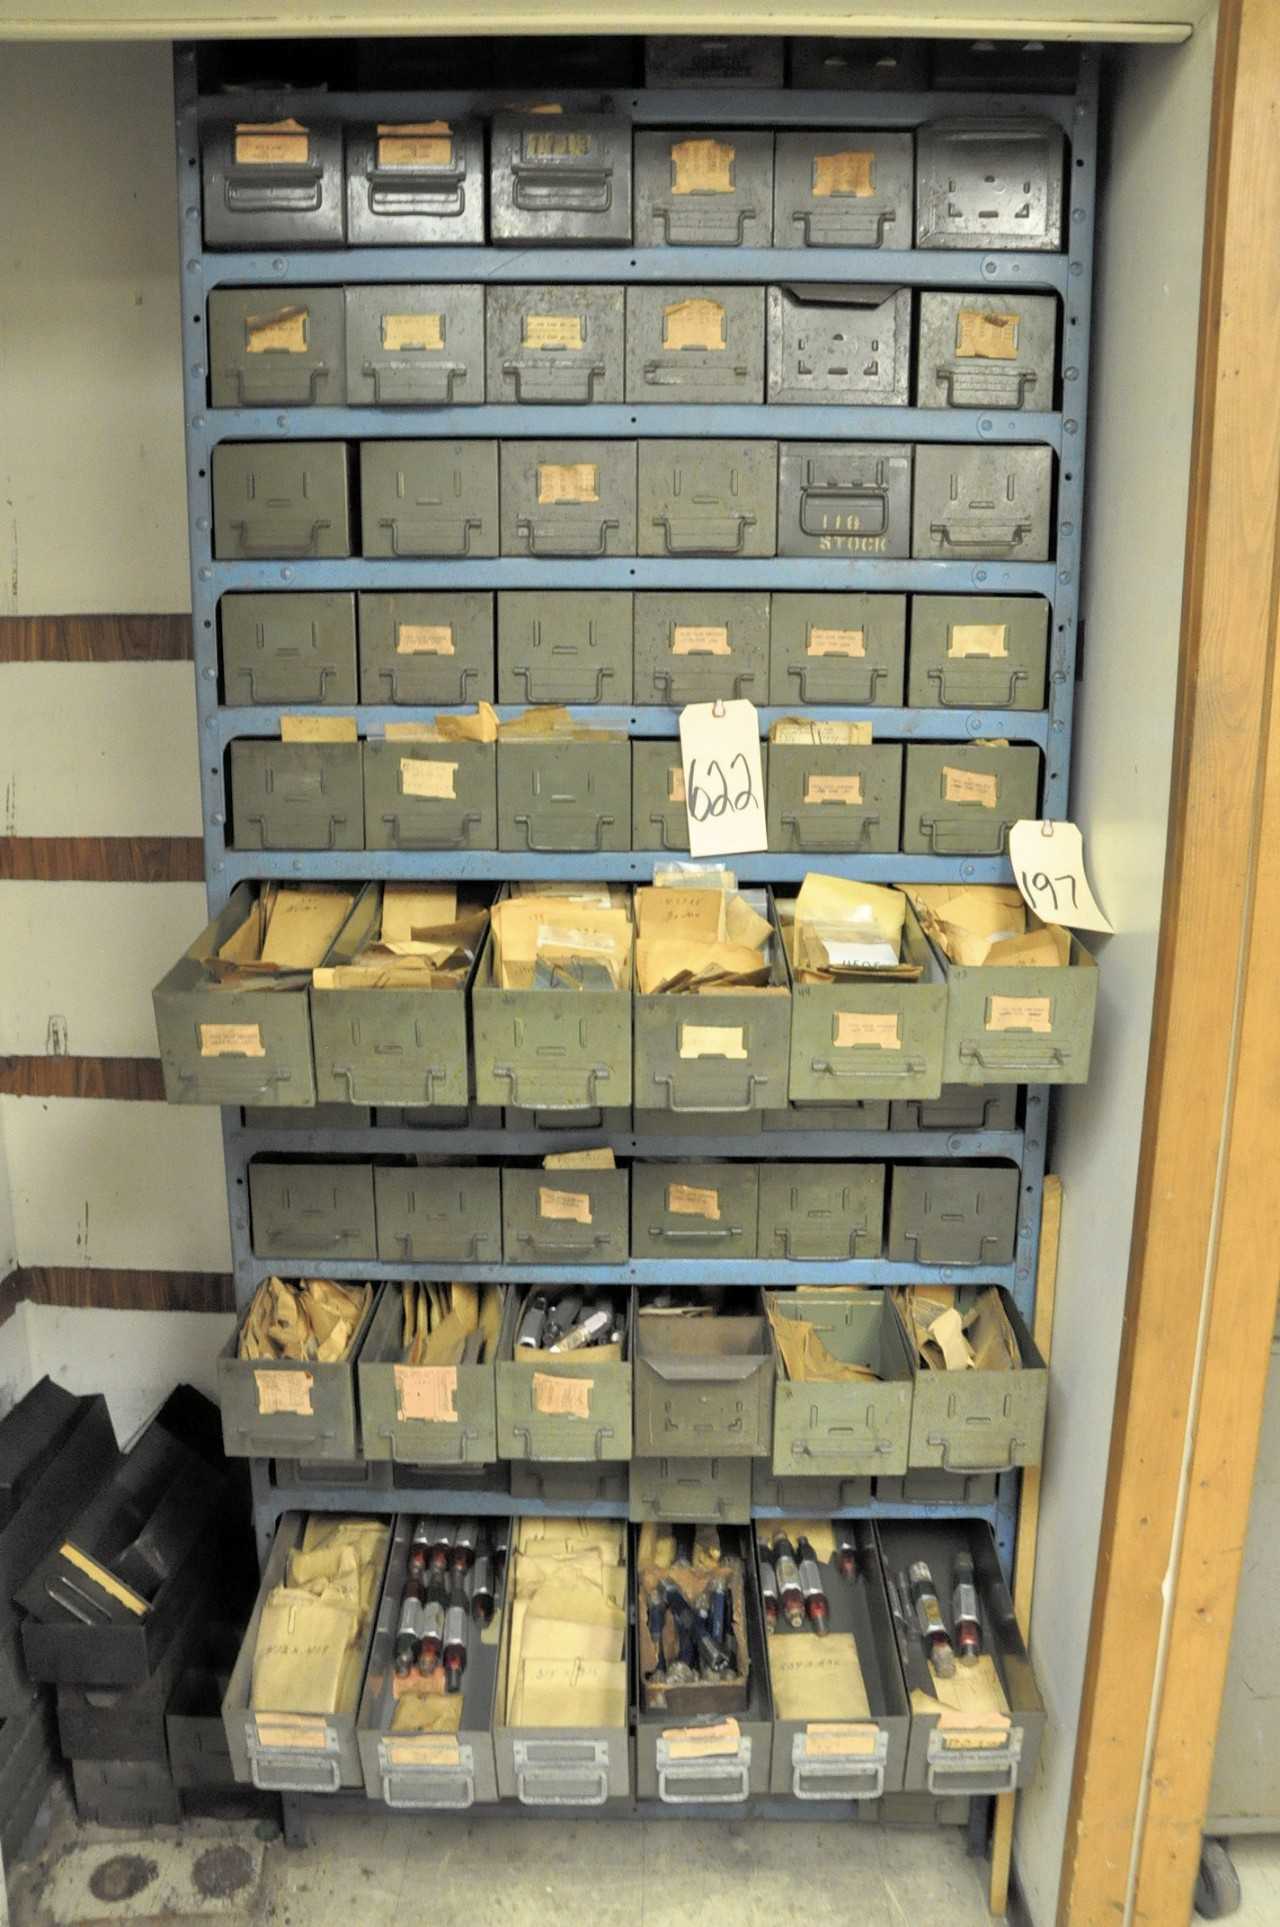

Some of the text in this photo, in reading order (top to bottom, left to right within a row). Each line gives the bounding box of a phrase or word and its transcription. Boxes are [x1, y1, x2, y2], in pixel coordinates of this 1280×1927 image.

[818, 535, 889, 552] STOCK
[688, 753, 759, 822] 622
[1021, 871, 1079, 910] 197
